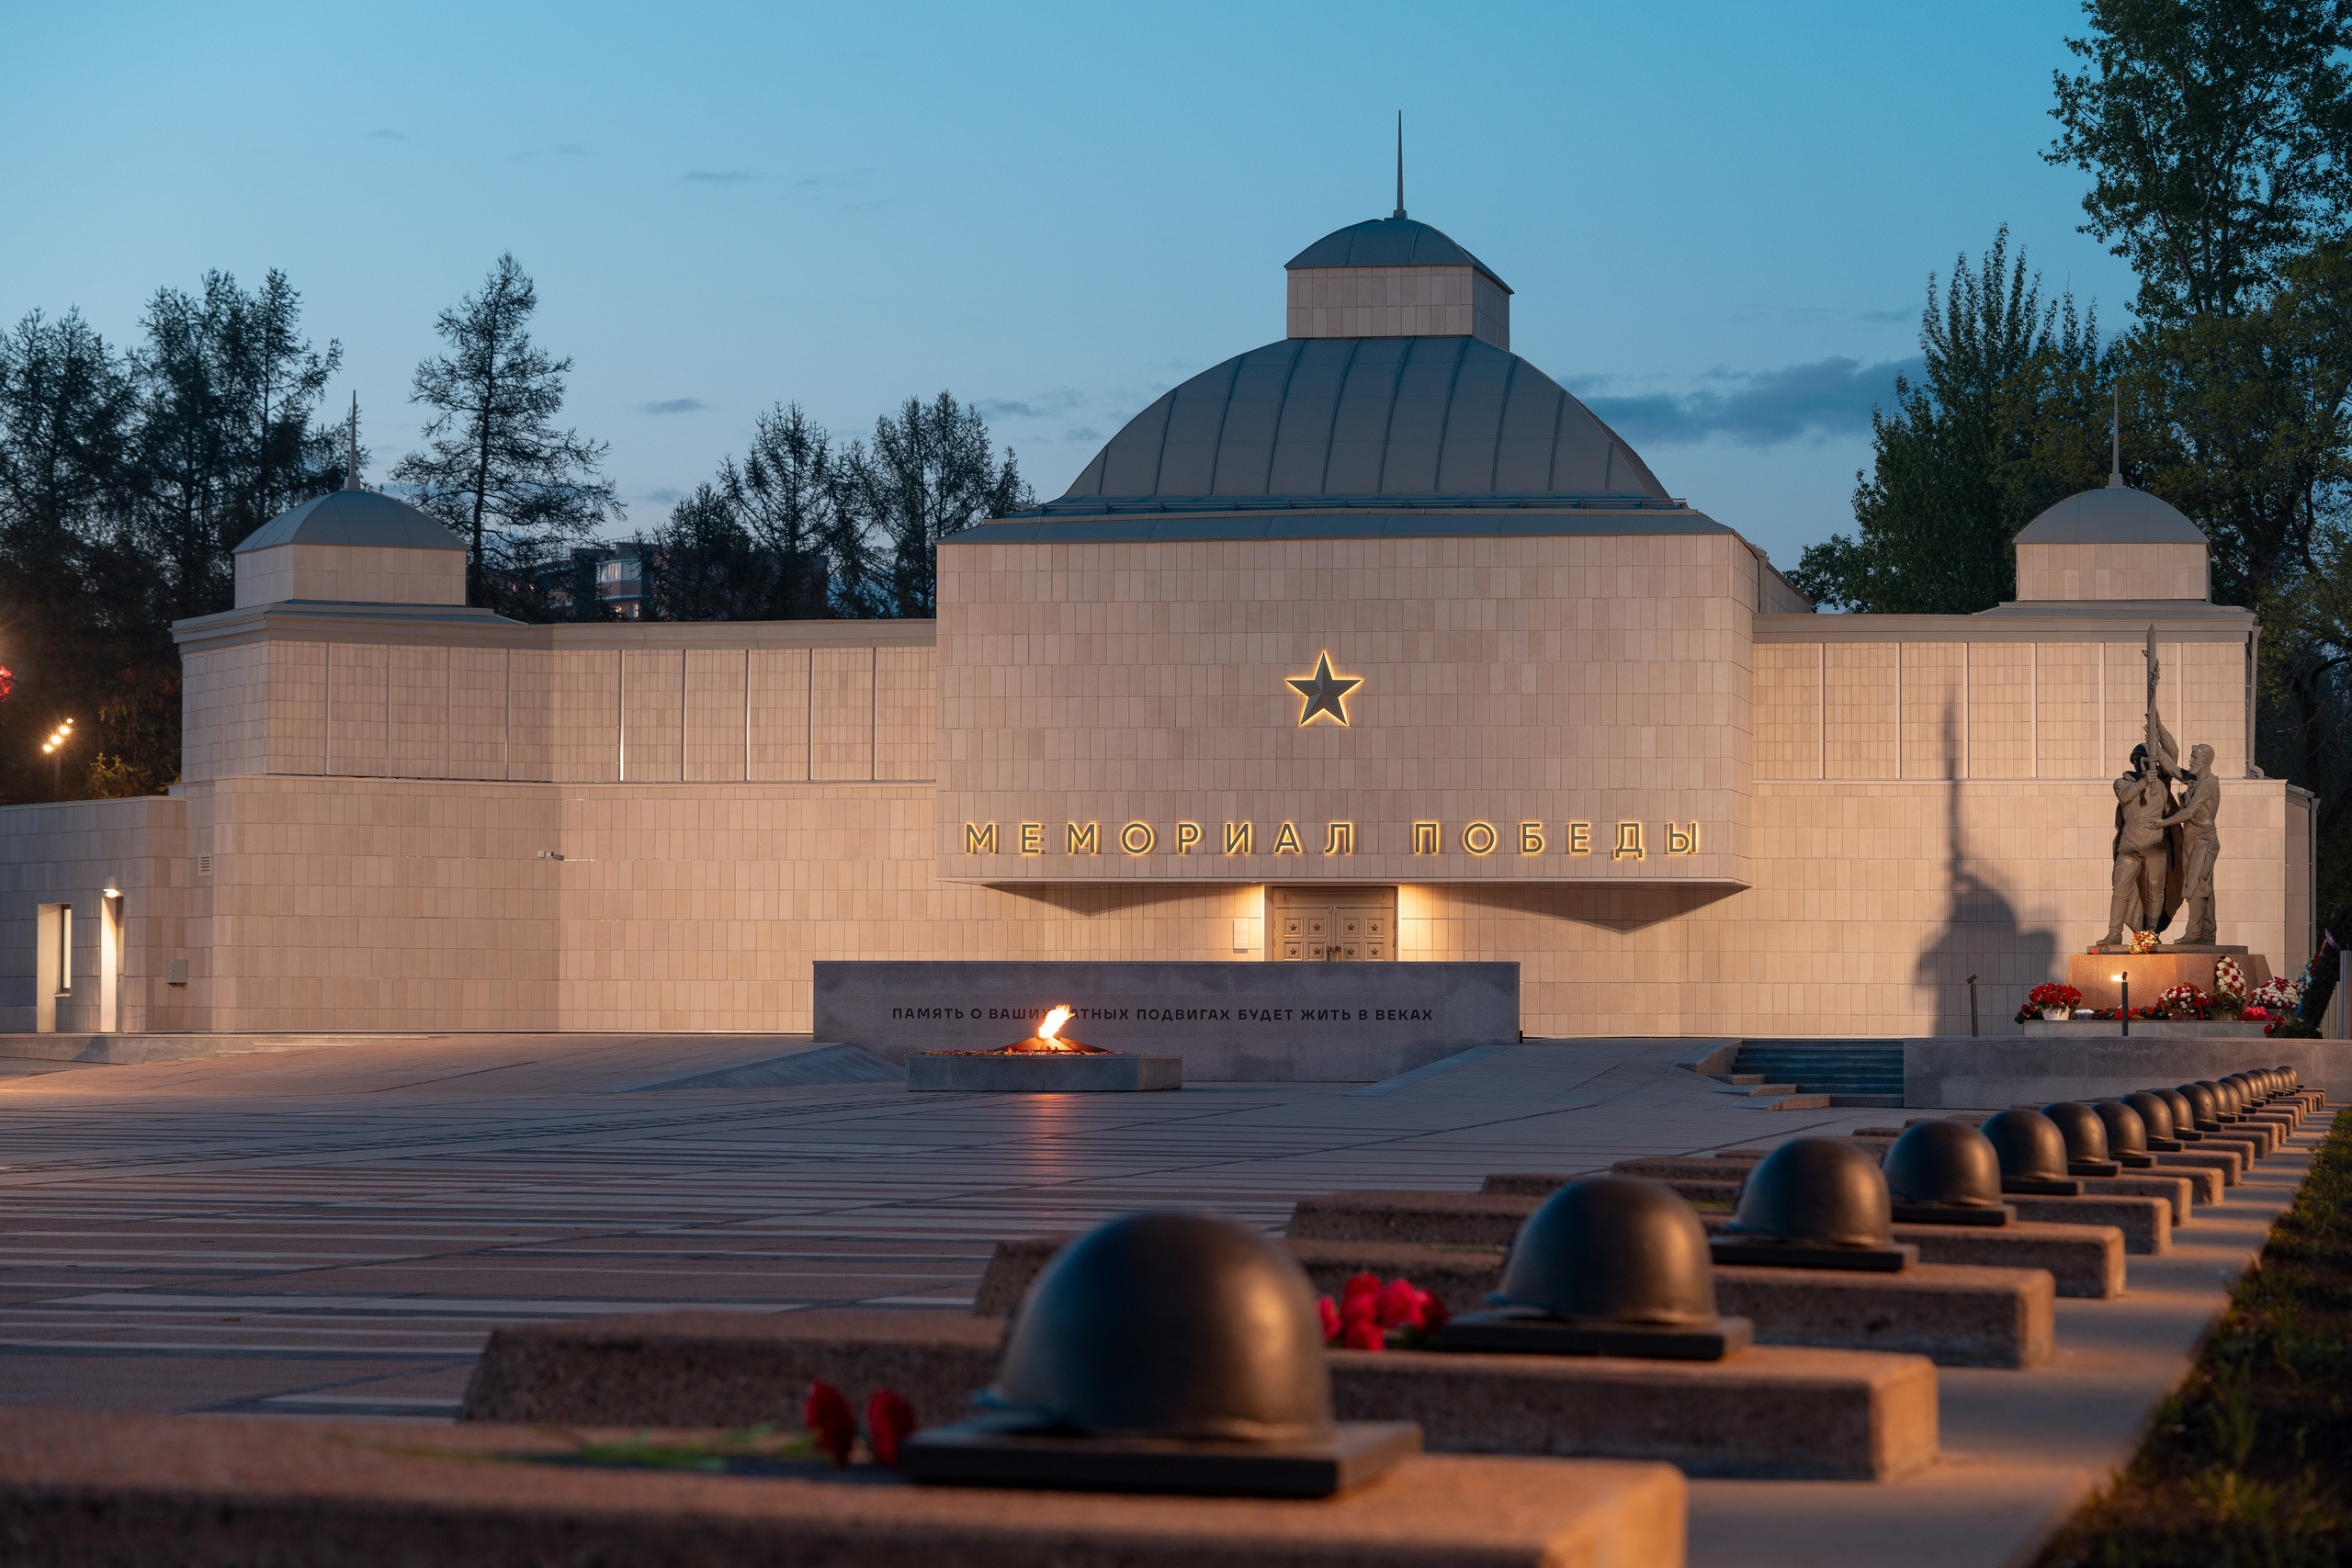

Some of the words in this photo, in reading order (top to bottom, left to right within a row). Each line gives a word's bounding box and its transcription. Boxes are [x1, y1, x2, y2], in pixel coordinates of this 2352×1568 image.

[965, 821, 1354, 855] МЕМОРИАЛ
[1415, 821, 1701, 860] ПОБЕДЫ
[892, 1008, 965, 1020] ПАМЯТЬ
[970, 1008, 982, 1020] О
[1136, 1009, 1230, 1021] ПОДВИГАХ
[1238, 1009, 1294, 1021] БУДЕТ
[1300, 1009, 1351, 1021] ЖИТЬ
[1358, 1009, 1368, 1021] В
[1375, 1009, 1432, 1021] ВЕКАХ
